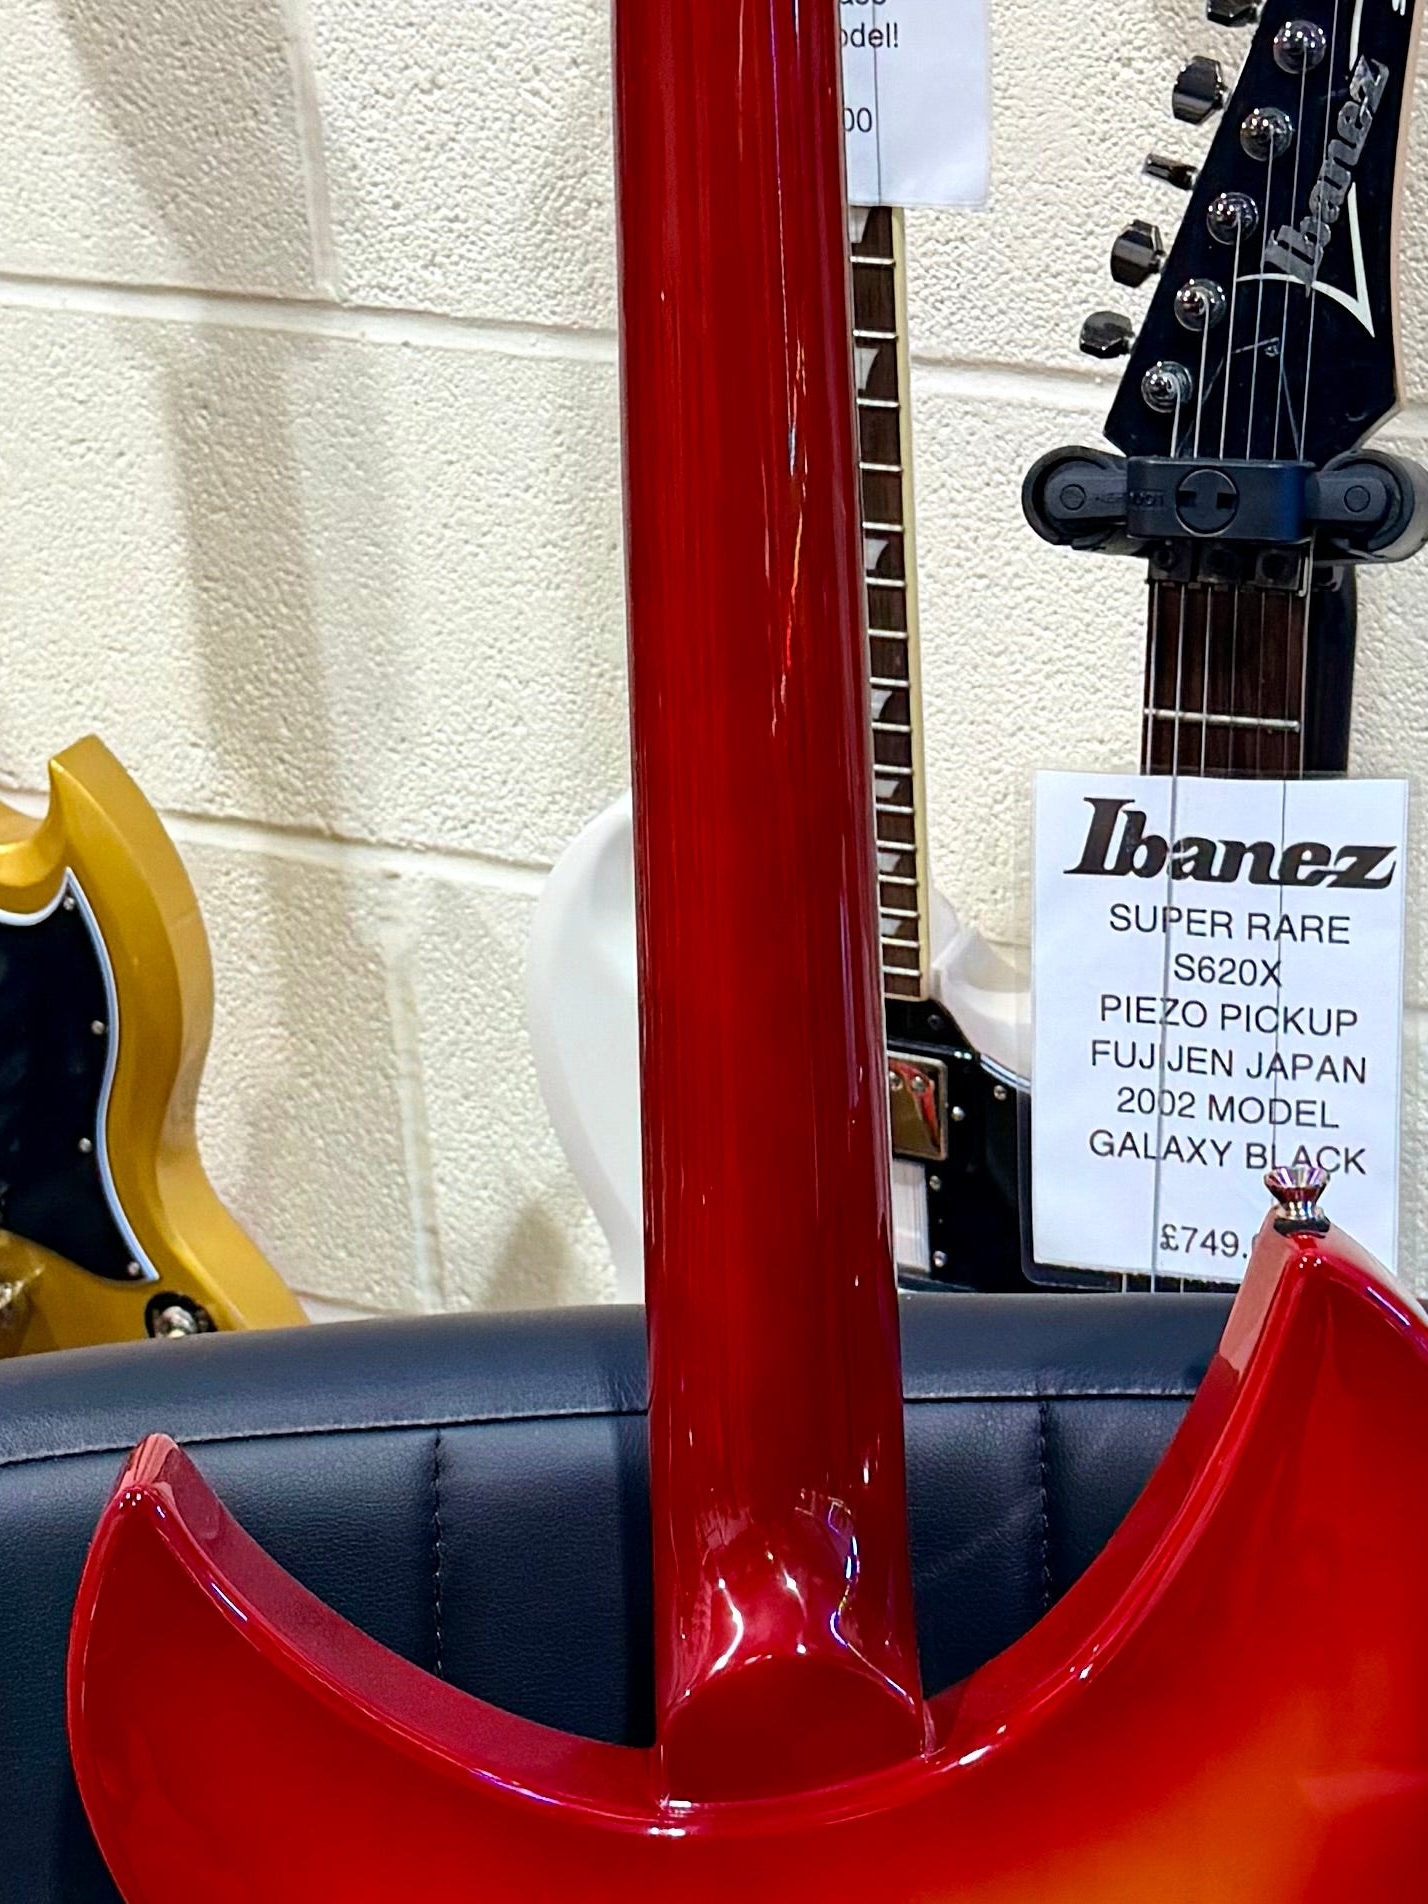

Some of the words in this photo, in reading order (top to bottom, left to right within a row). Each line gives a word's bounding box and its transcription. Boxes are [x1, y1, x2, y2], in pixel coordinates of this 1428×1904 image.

[1263, 52, 1391, 298] Ibanez
[1063, 796, 1398, 891] Ibanez
[1108, 902, 1234, 940] SUPER
[1247, 911, 1351, 946] RARE
[1173, 952, 1283, 988] S620X
[1100, 993, 1209, 1029] PIEZO
[1219, 1003, 1360, 1038] PICKUP
[1090, 1039, 1235, 1079] FUJJEN
[1245, 1050, 1368, 1086] JAPAN
[1115, 1086, 1197, 1120] 2002
[1208, 1096, 1341, 1130] MODEL
[1088, 1128, 1233, 1168] GALAXY
[1245, 1141, 1368, 1176] BLACK
[1159, 1223, 1259, 1260] £749.
